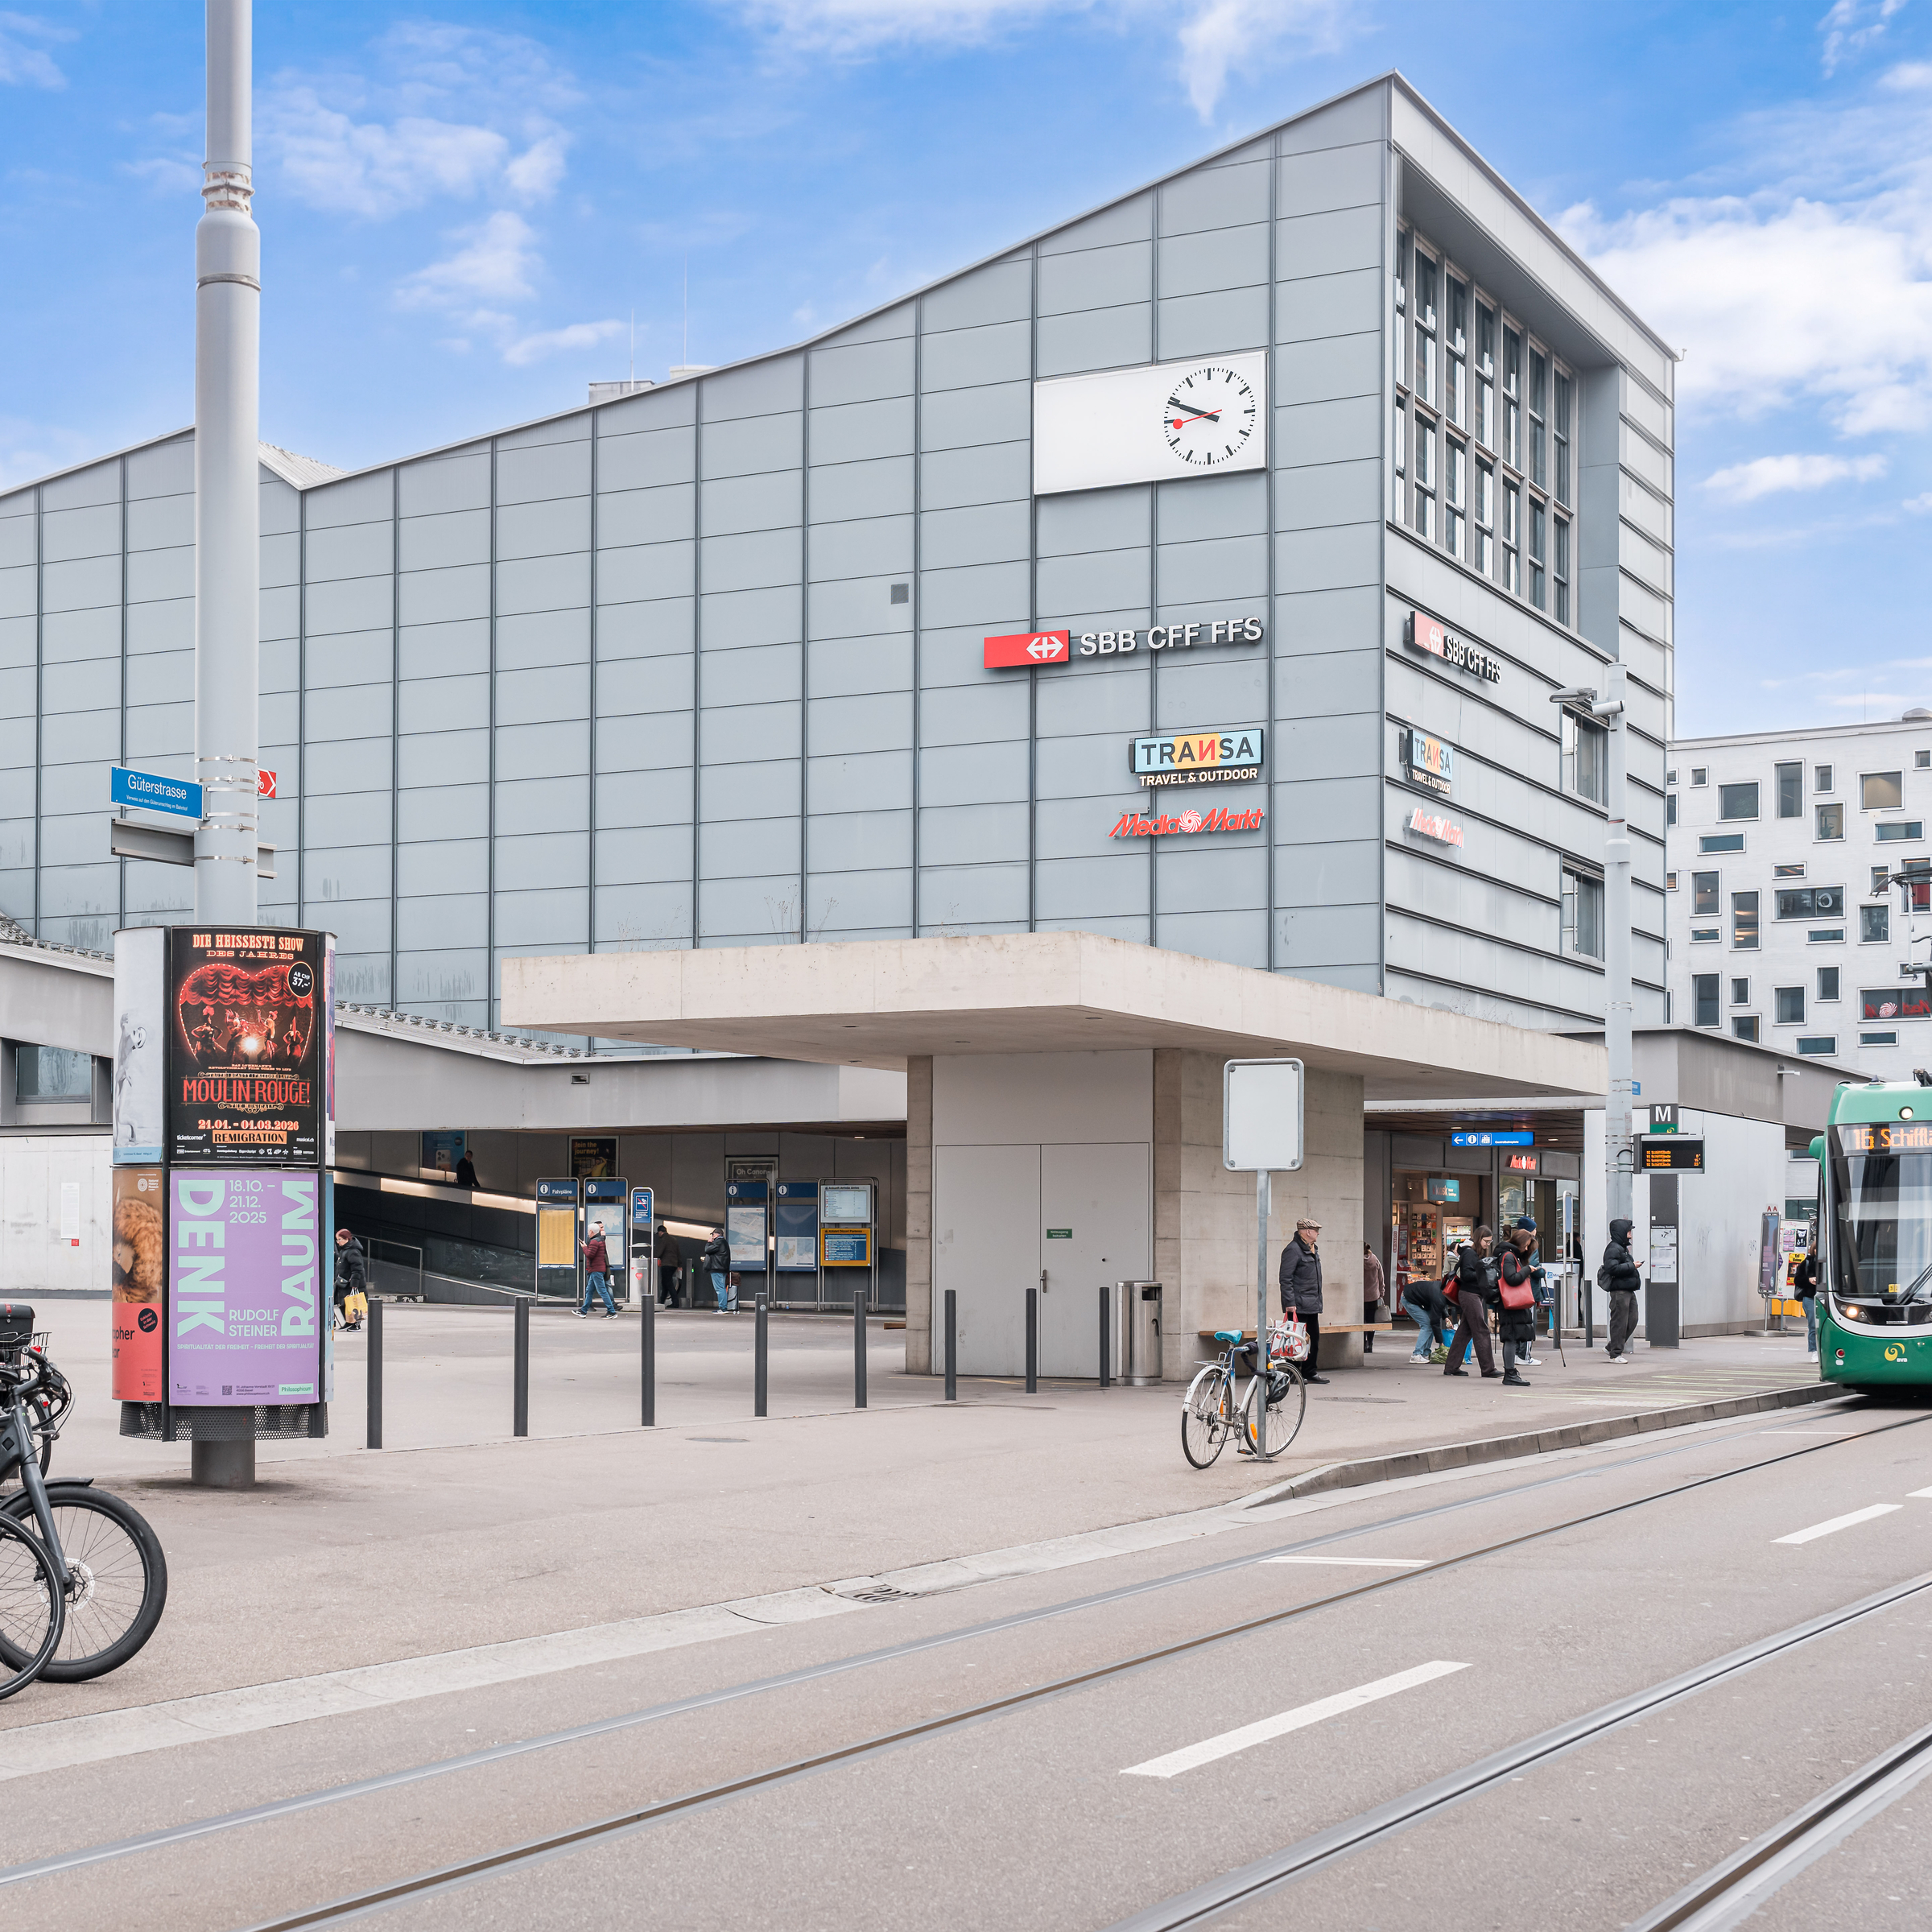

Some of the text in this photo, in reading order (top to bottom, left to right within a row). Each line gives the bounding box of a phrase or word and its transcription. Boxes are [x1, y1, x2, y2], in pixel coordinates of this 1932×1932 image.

[1080, 617, 1264, 656] SBB CFF FFS
[1447, 636, 1501, 683] SBB CFF FFS
[1141, 736, 1254, 765] TRANSA
[1414, 738, 1451, 774] TRANSA
[1139, 768, 1258, 786] TRAVEL & OUTDOOR
[1412, 769, 1428, 785] TRAVEL
[1431, 778, 1451, 794] OUTDOOR
[128, 774, 187, 799] Güterstrasse
[192, 934, 304, 952] DIE HEISSESTE SHOW
[239, 952, 295, 960] JAHRES
[183, 1080, 310, 1104] MOULIN ROUGE!
[1655, 1105, 1671, 1121] M
[198, 1119, 232, 1129] 21.01.
[241, 1120, 299, 1131] 01.03.2026
[215, 1133, 284, 1142] REMIGRATION
[1853, 1128, 1874, 1150] 16
[229, 1180, 264, 1192] 18.10.
[229, 1196, 262, 1208] 21.12.
[229, 1212, 266, 1224] 2025
[177, 1179, 225, 1338] DENK
[281, 1180, 315, 1336] RAUM
[229, 1309, 279, 1321] RUDOLF
[229, 1325, 278, 1337] STEINER
